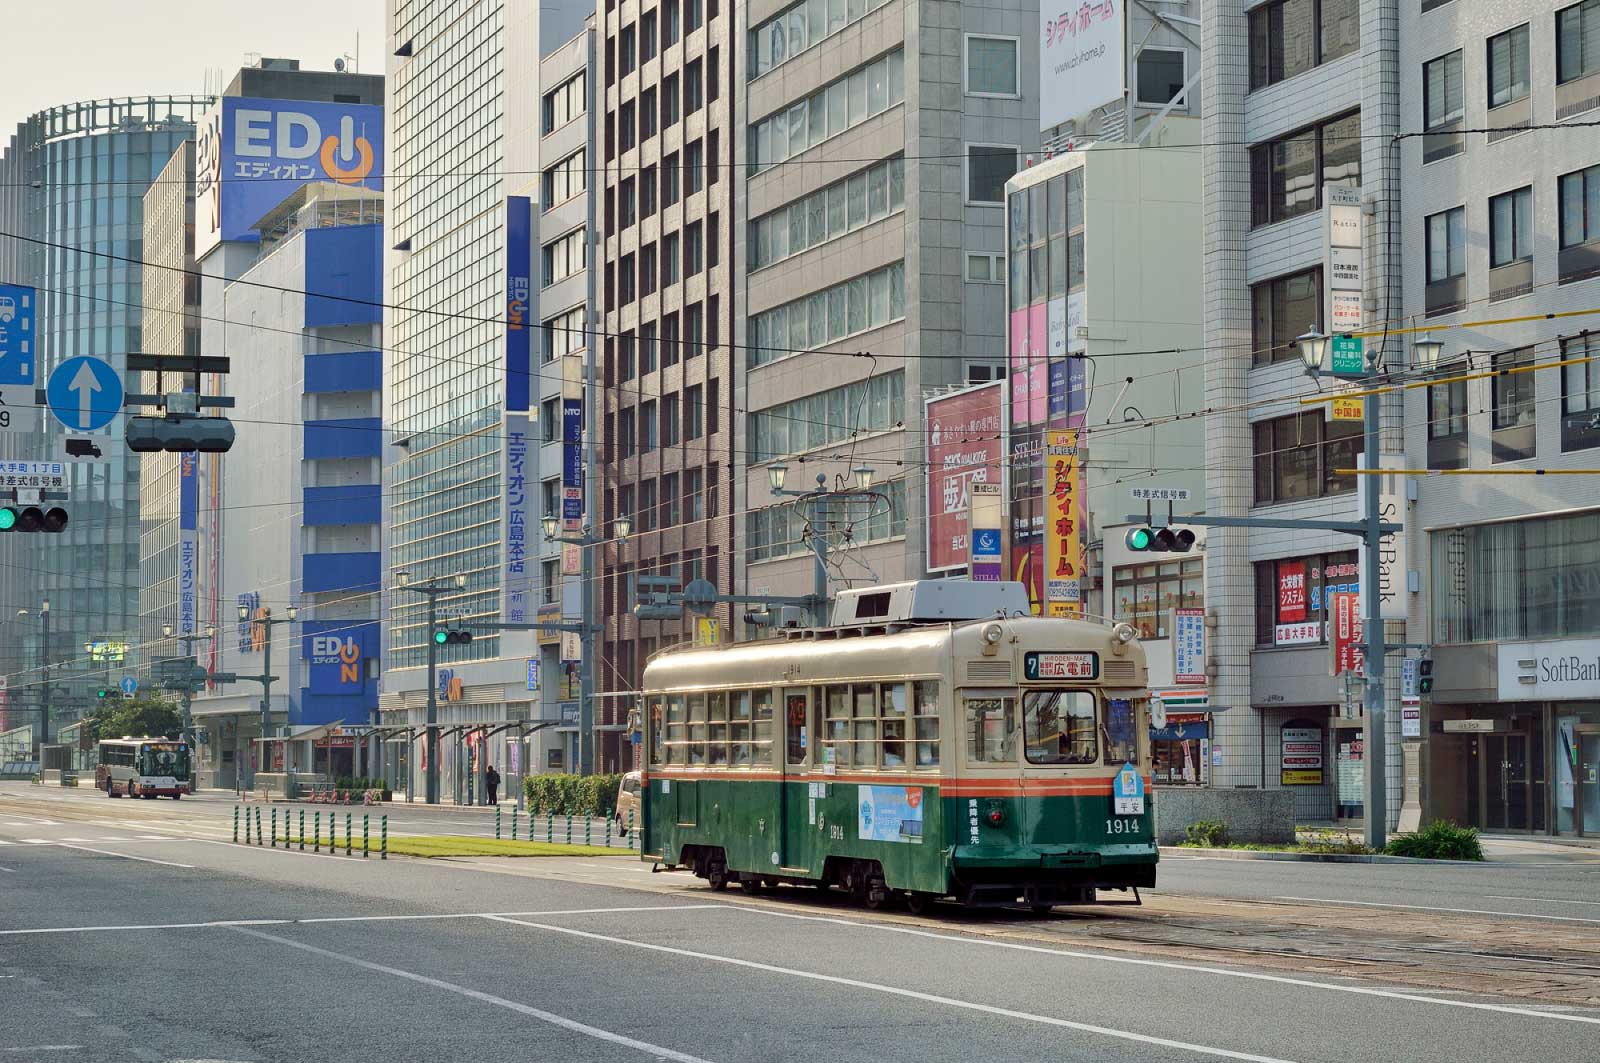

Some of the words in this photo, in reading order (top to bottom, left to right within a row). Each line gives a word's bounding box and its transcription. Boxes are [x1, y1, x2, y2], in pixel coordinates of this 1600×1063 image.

[234, 110, 374, 190] EDIO
[234, 161, 316, 179] エディオン
[509, 277, 528, 330] EDION
[1335, 408, 1361, 417] 中国語
[1056, 437, 1069, 445] Life
[1014, 440, 1045, 460] STELL
[0, 463, 61, 473] 大手町1丁目
[973, 485, 999, 493] 豊成ビル
[1133, 489, 1187, 500] 時差式信号機
[510, 433, 524, 573] エディオン広島本店
[1055, 460, 1074, 577] シティホーム
[1281, 574, 1304, 590] 大栄教育
[1281, 590, 1304, 605] システム
[312, 636, 361, 684] EDION
[1028, 658, 1037, 674] 7
[1054, 663, 1091, 675] 広電前
[1120, 803, 1139, 813] 平安
[830, 825, 843, 840] 1914
[1106, 819, 1140, 834] 1914
